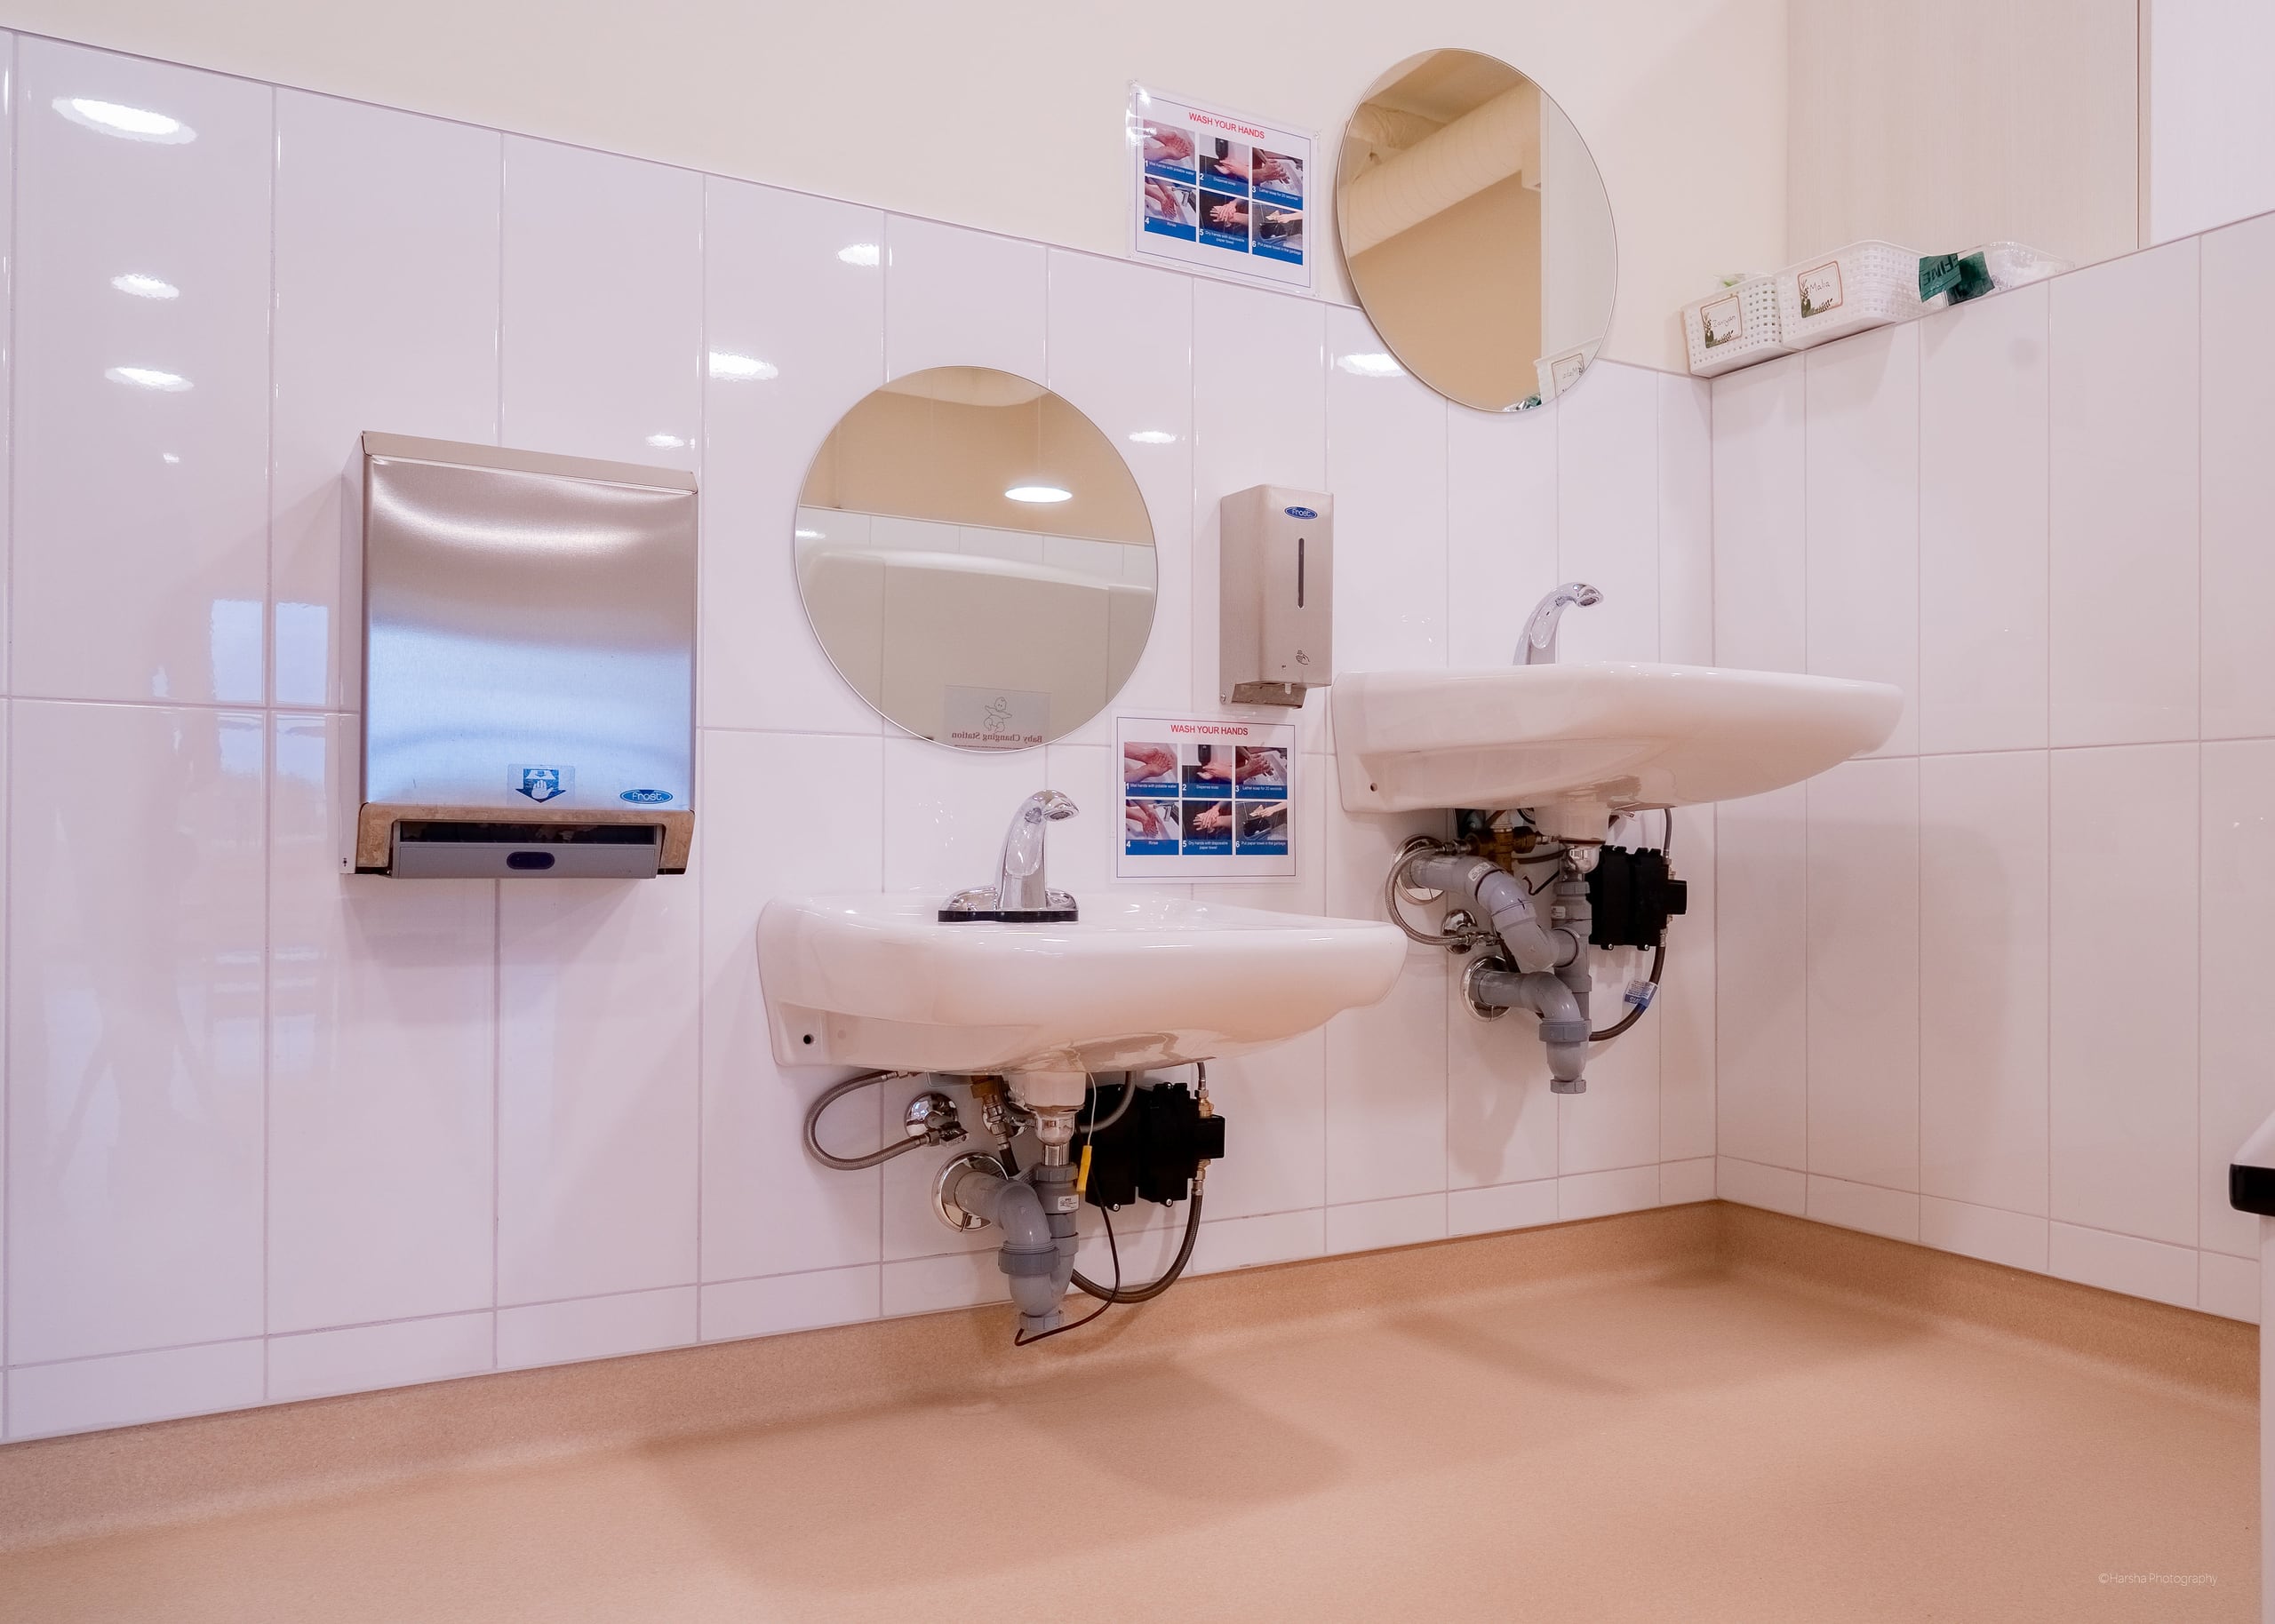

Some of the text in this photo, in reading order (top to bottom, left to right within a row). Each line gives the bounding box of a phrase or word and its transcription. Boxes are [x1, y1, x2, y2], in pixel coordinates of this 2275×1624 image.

[1189, 112, 1265, 139] WASH YOUR HANDS
[1200, 172, 1204, 181] 2
[1170, 724, 1249, 736] WASH YOUR HANDS
